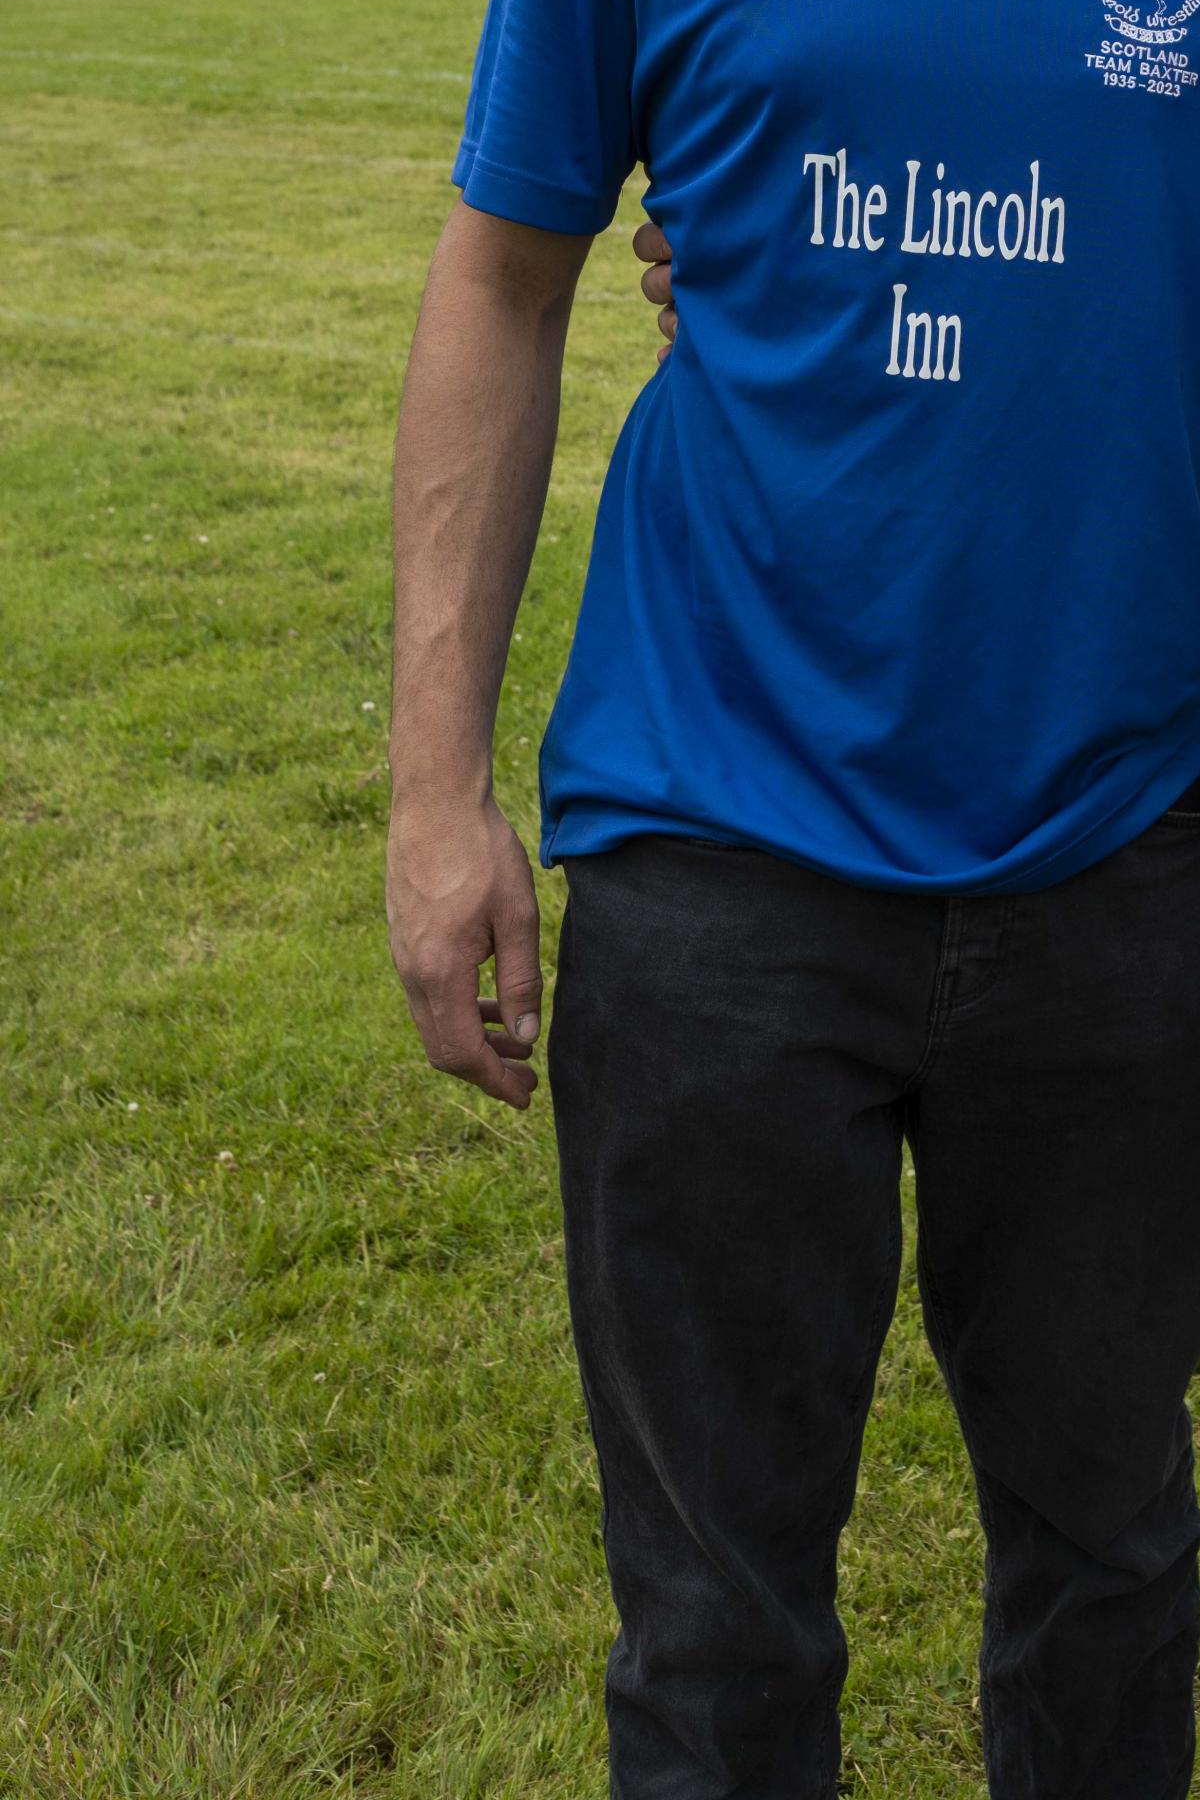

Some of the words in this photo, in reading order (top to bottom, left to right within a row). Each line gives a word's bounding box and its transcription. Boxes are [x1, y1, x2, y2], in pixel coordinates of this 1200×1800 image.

[1084, 53, 1132, 74] TEAM
[1140, 62, 1199, 87] BAXTER
[1100, 40, 1189, 68] SCOTLAND
[803, 148, 888, 252] The
[900, 159, 1065, 264] Lincoln
[885, 283, 962, 382] Inn
